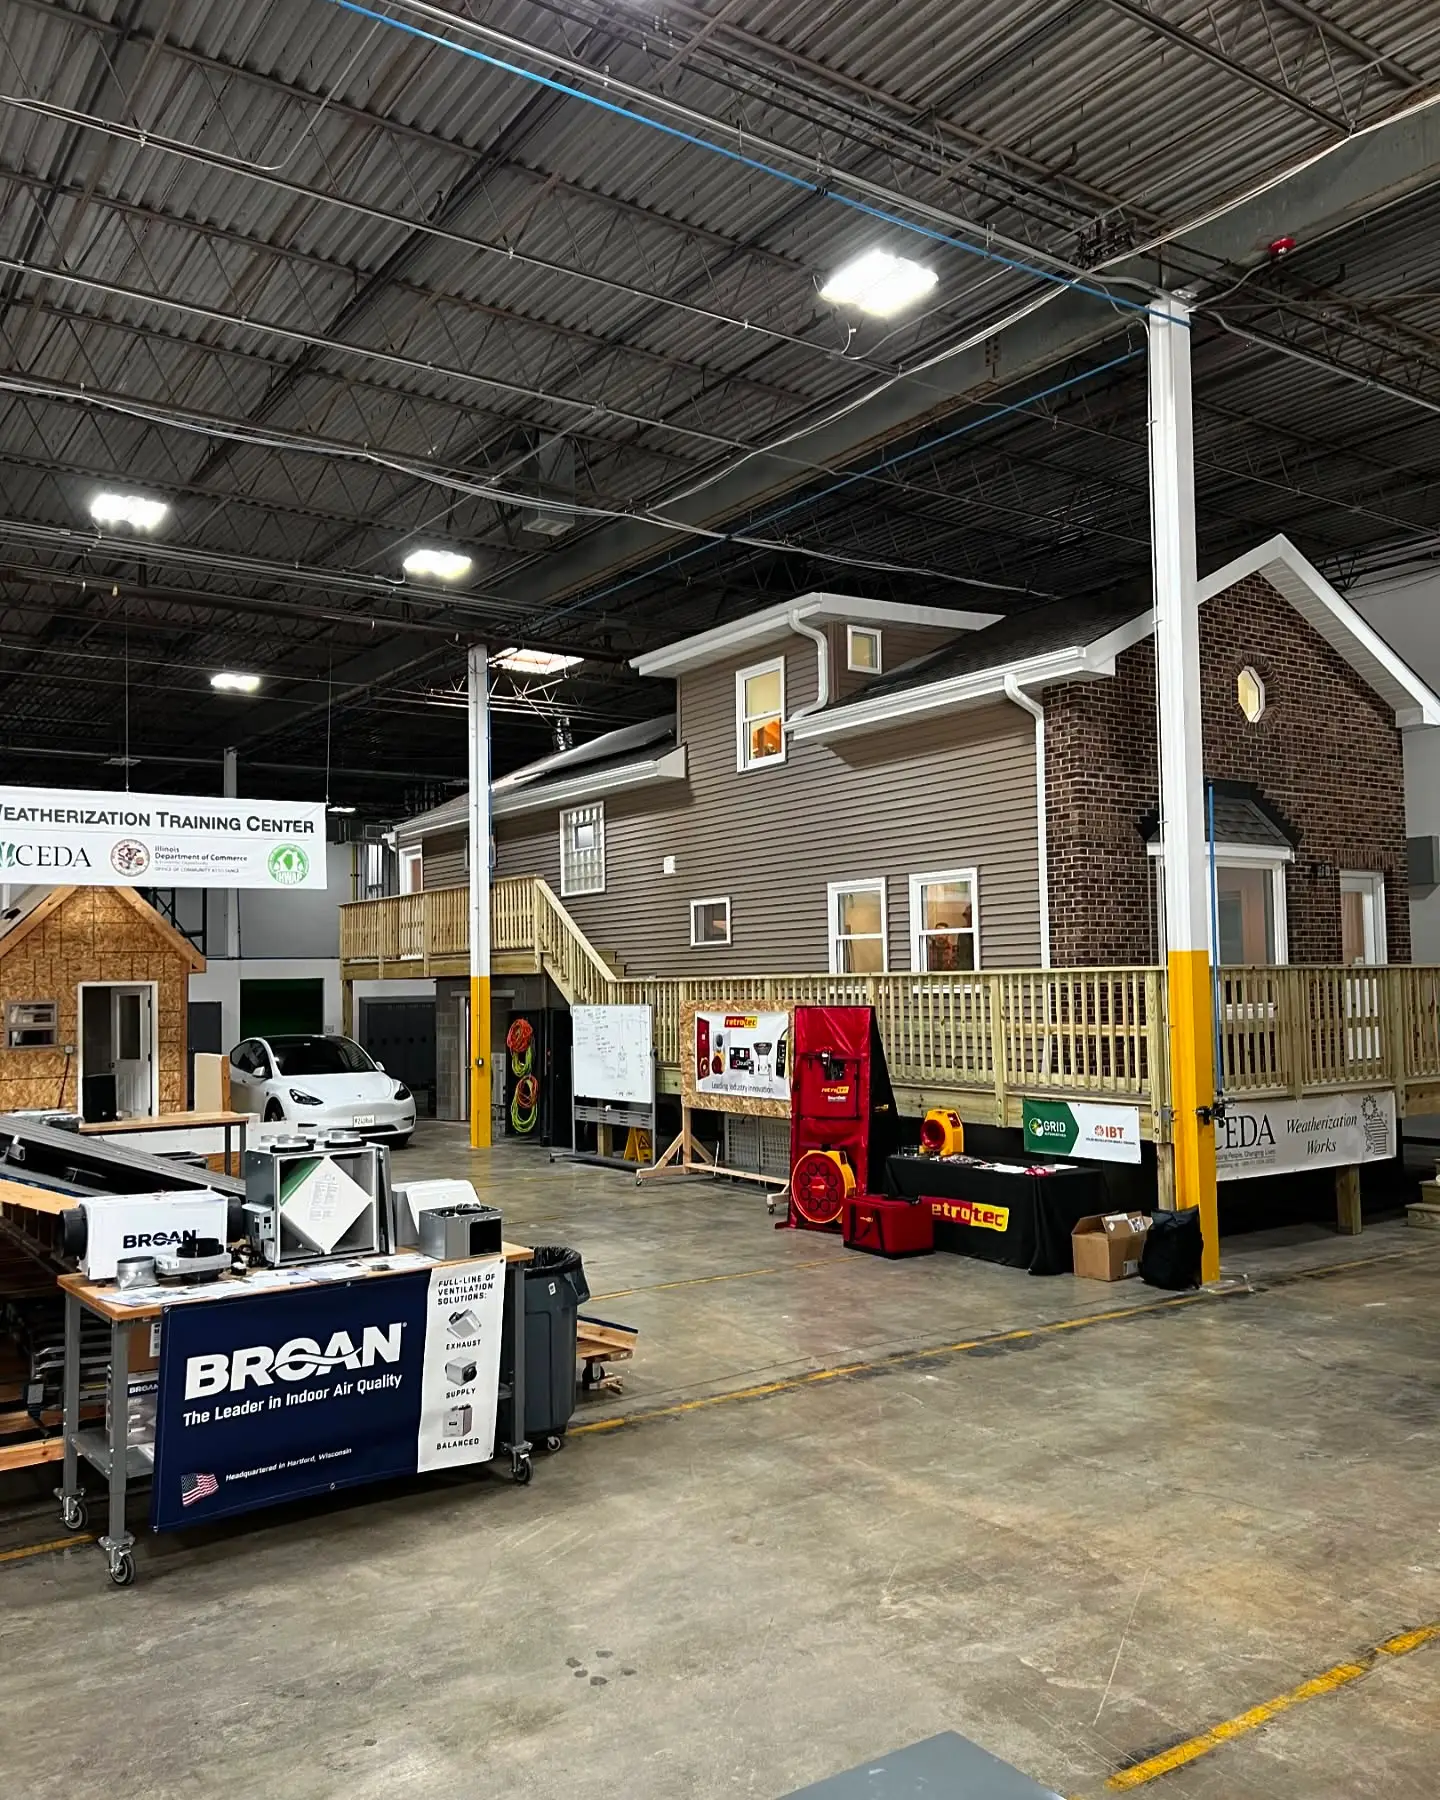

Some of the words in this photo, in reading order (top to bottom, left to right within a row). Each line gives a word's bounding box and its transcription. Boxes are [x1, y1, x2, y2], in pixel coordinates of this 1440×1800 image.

[0, 804, 150, 827] EATHERIZATION
[156, 811, 241, 831] TRAINING
[247, 815, 315, 834] CENTER
[15, 844, 92, 868] CEDA
[154, 845, 180, 853] Illinois
[154, 852, 200, 861] Department
[201, 853, 209, 861] of
[210, 853, 248, 862] Commerce
[725, 1018, 757, 1027] retrotec
[711, 1081, 729, 1091] Leading
[729, 1082, 748, 1093] industry
[1043, 1120, 1066, 1133] GRID
[1286, 1113, 1357, 1134] Weatherization
[1105, 1125, 1125, 1139] IBT
[1306, 1138, 1337, 1155] Works
[931, 1202, 1004, 1227] etrotec
[123, 1229, 197, 1249] BROAN
[438, 1274, 482, 1288] FULL-LINE
[485, 1273, 496, 1281] OF
[438, 1283, 494, 1296] VENTILATION
[437, 1292, 487, 1305] SOLUTIONS:
[446, 1339, 481, 1350] EXHAUST
[184, 1322, 402, 1401] BROAN
[446, 1387, 476, 1399] SUPPLY
[183, 1410, 210, 1427] The
[214, 1399, 265, 1421] Leader
[268, 1395, 281, 1410] in
[286, 1388, 330, 1407] Indoor
[333, 1381, 354, 1398] Air
[357, 1374, 403, 1395] Quality
[436, 1437, 480, 1450] BALANCED
[225, 1463, 278, 1482] Headquartered
[278, 1462, 286, 1470] in
[287, 1455, 317, 1468] Hartford,
[318, 1447, 353, 1461] Wisconsin
